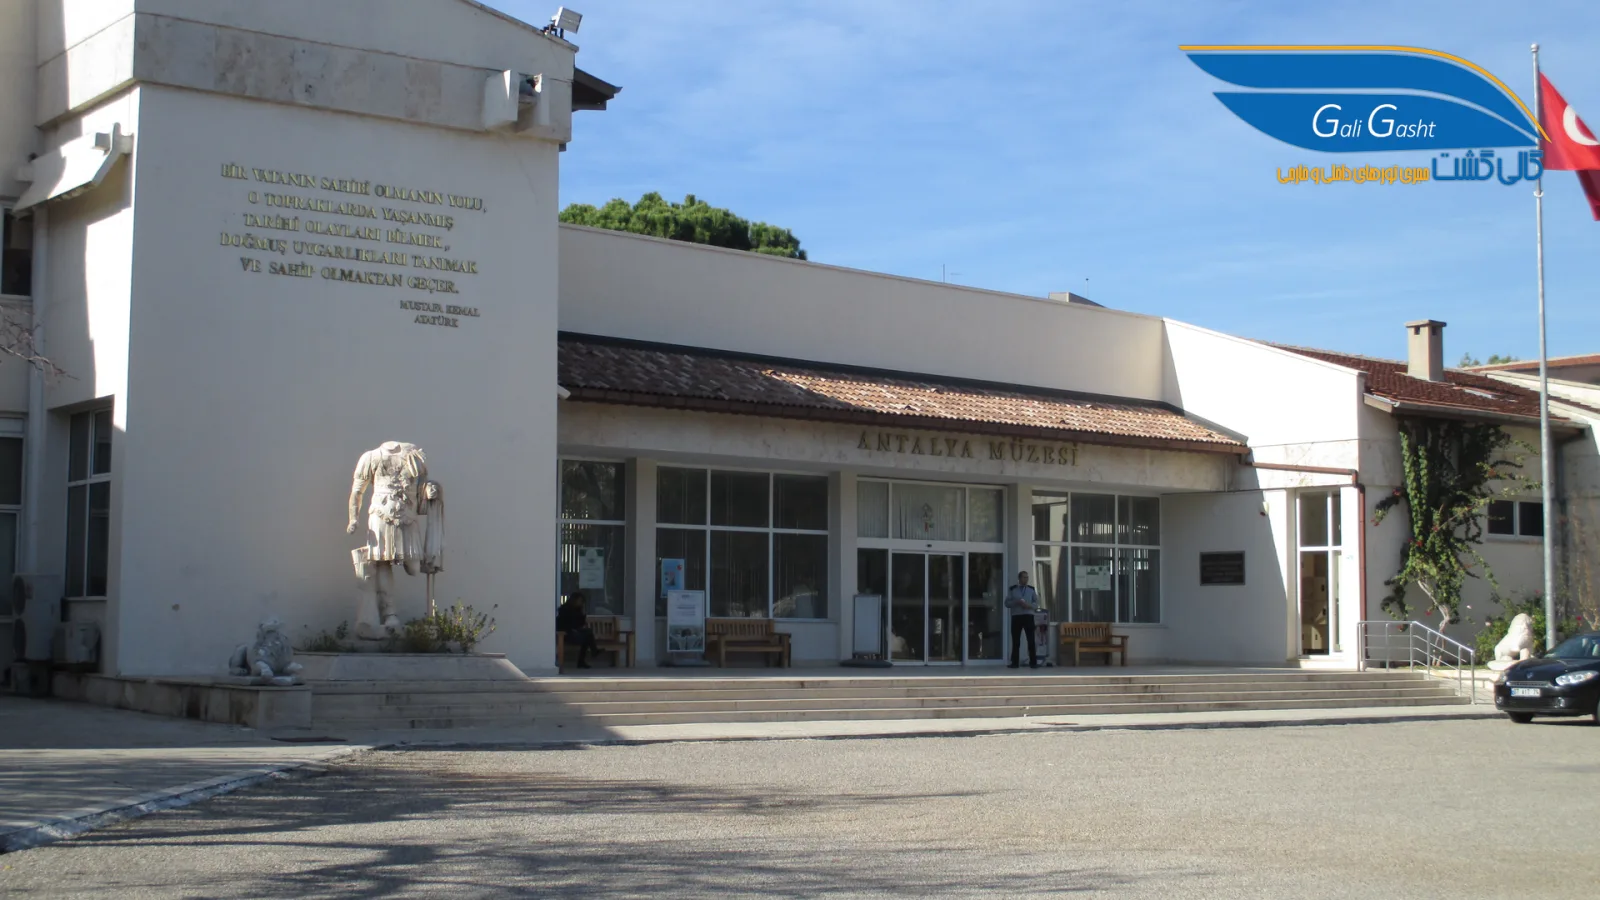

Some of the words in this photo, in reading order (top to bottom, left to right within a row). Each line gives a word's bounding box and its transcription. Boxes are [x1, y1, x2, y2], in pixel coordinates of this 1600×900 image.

[252, 168, 316, 188] VATANIN
[375, 184, 443, 205] OLMANIN
[264, 192, 377, 219] TOPRAKLARDA
[305, 220, 381, 242] OLAYLARI
[240, 256, 262, 273] VE
[321, 267, 403, 287] OLMAKTAN
[293, 240, 407, 266] UYGARLIKLARI
[411, 255, 478, 274] TANIMAK
[400, 299, 444, 313] MUSTAFA
[446, 304, 481, 317] KEMAL
[414, 314, 459, 328] ATATÜRK
[857, 430, 975, 460] ANTALYA
[988, 437, 1080, 467] MÜZESİ
